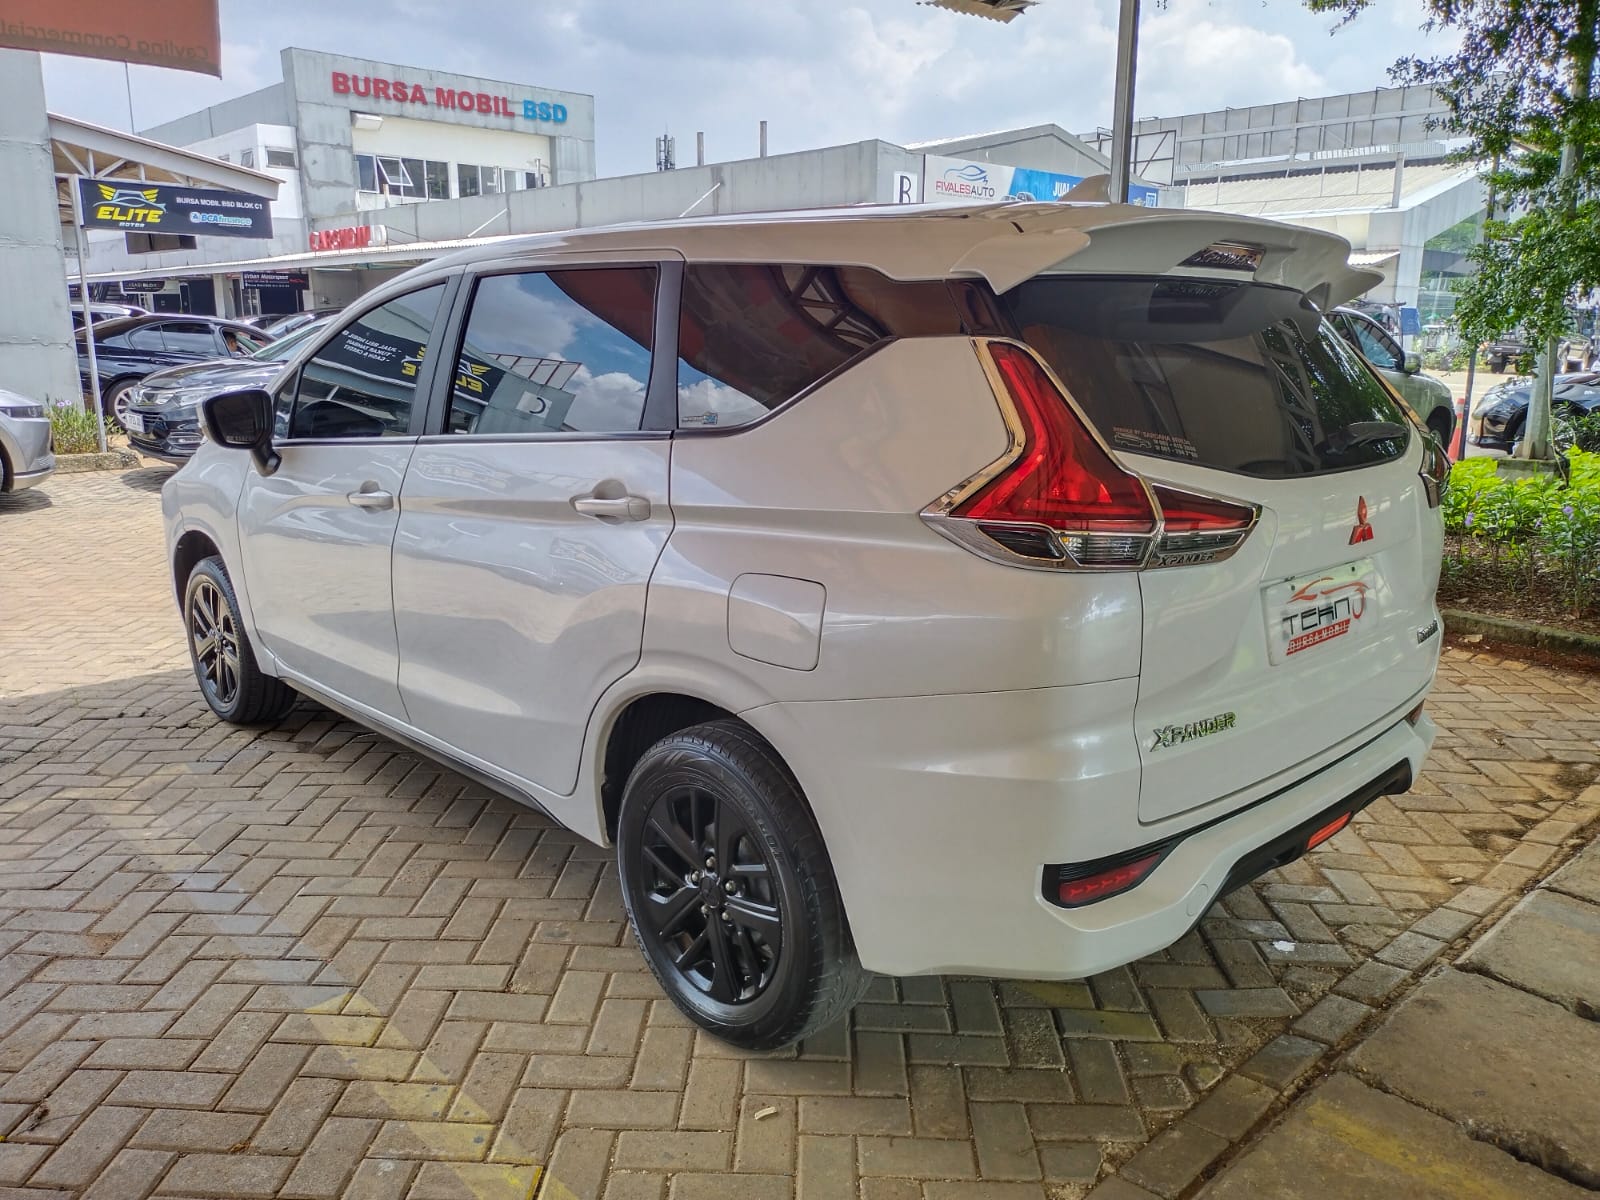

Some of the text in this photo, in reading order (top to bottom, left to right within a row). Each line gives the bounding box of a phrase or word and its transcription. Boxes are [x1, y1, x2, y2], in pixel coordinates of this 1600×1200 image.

[331, 71, 568, 124] BURSA MOBIL BSD
[935, 180, 995, 198] FIVALESAUTO
[176, 197, 200, 206] BURSA
[200, 198, 221, 207] MOBIL
[236, 201, 254, 209] BLOK
[96, 206, 163, 223] ELITE
[1149, 711, 1236, 752] XPANDER
